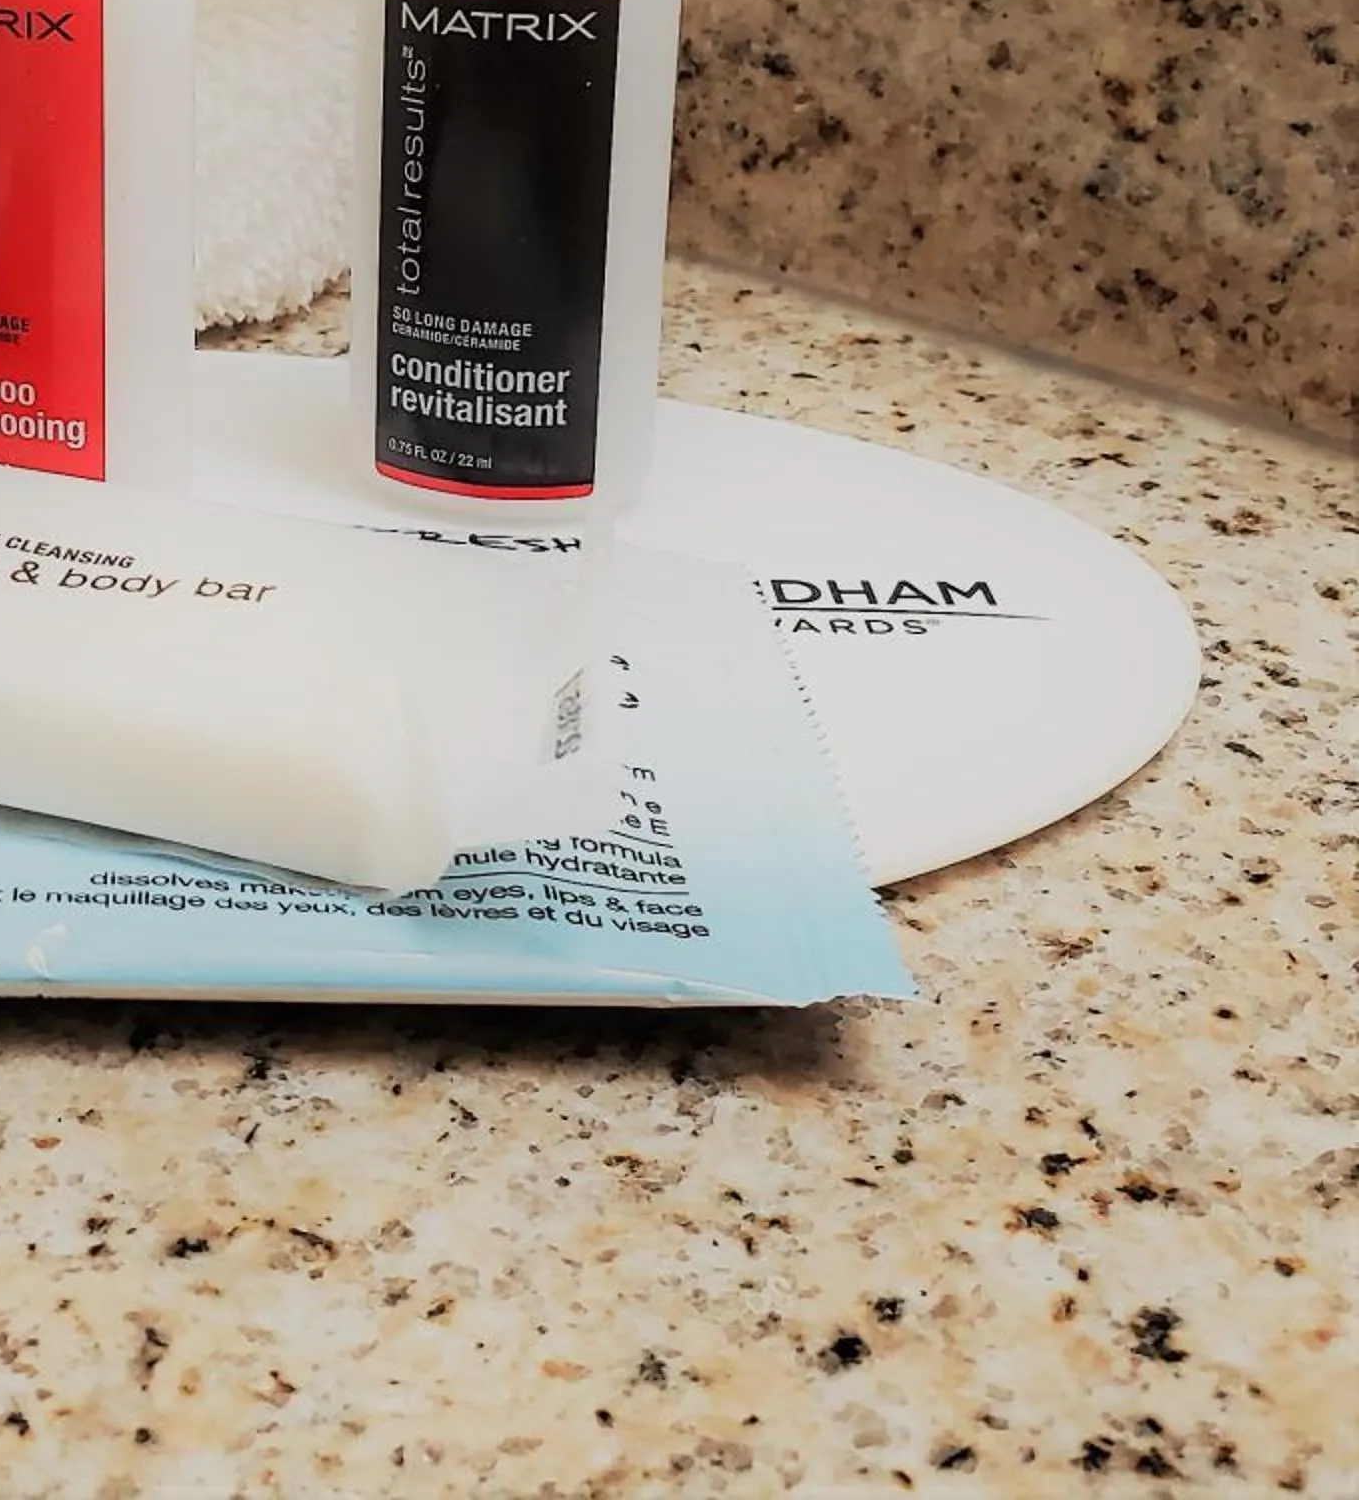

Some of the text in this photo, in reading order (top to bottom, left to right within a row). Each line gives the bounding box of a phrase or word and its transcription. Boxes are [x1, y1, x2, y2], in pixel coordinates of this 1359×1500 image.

[401, 1, 598, 42] MATRIX
[392, 305, 533, 337] SO LONG DAMAGE
[391, 353, 572, 393] conditioner
[391, 385, 568, 427] revitalisant
[388, 437, 412, 456] 0.75
[414, 445, 427, 460] FL
[430, 449, 448, 462] OZ
[458, 453, 474, 467] 22
[476, 456, 492, 469] ml
[5, 536, 136, 569] CLEANSING
[11, 560, 42, 585] &
[58, 566, 181, 598] body
[193, 577, 279, 604] bar
[769, 579, 998, 605] DHAM
[524, 847, 687, 886] hydratante
[12, 886, 37, 902] le
[45, 889, 206, 911] maquillage
[214, 895, 269, 912] des
[366, 902, 422, 917] des
[527, 904, 556, 920] et
[564, 907, 603, 929] du
[611, 915, 711, 940] visage
[90, 870, 230, 892] dissolves
[543, 884, 597, 909] lips
[637, 897, 704, 917] face
